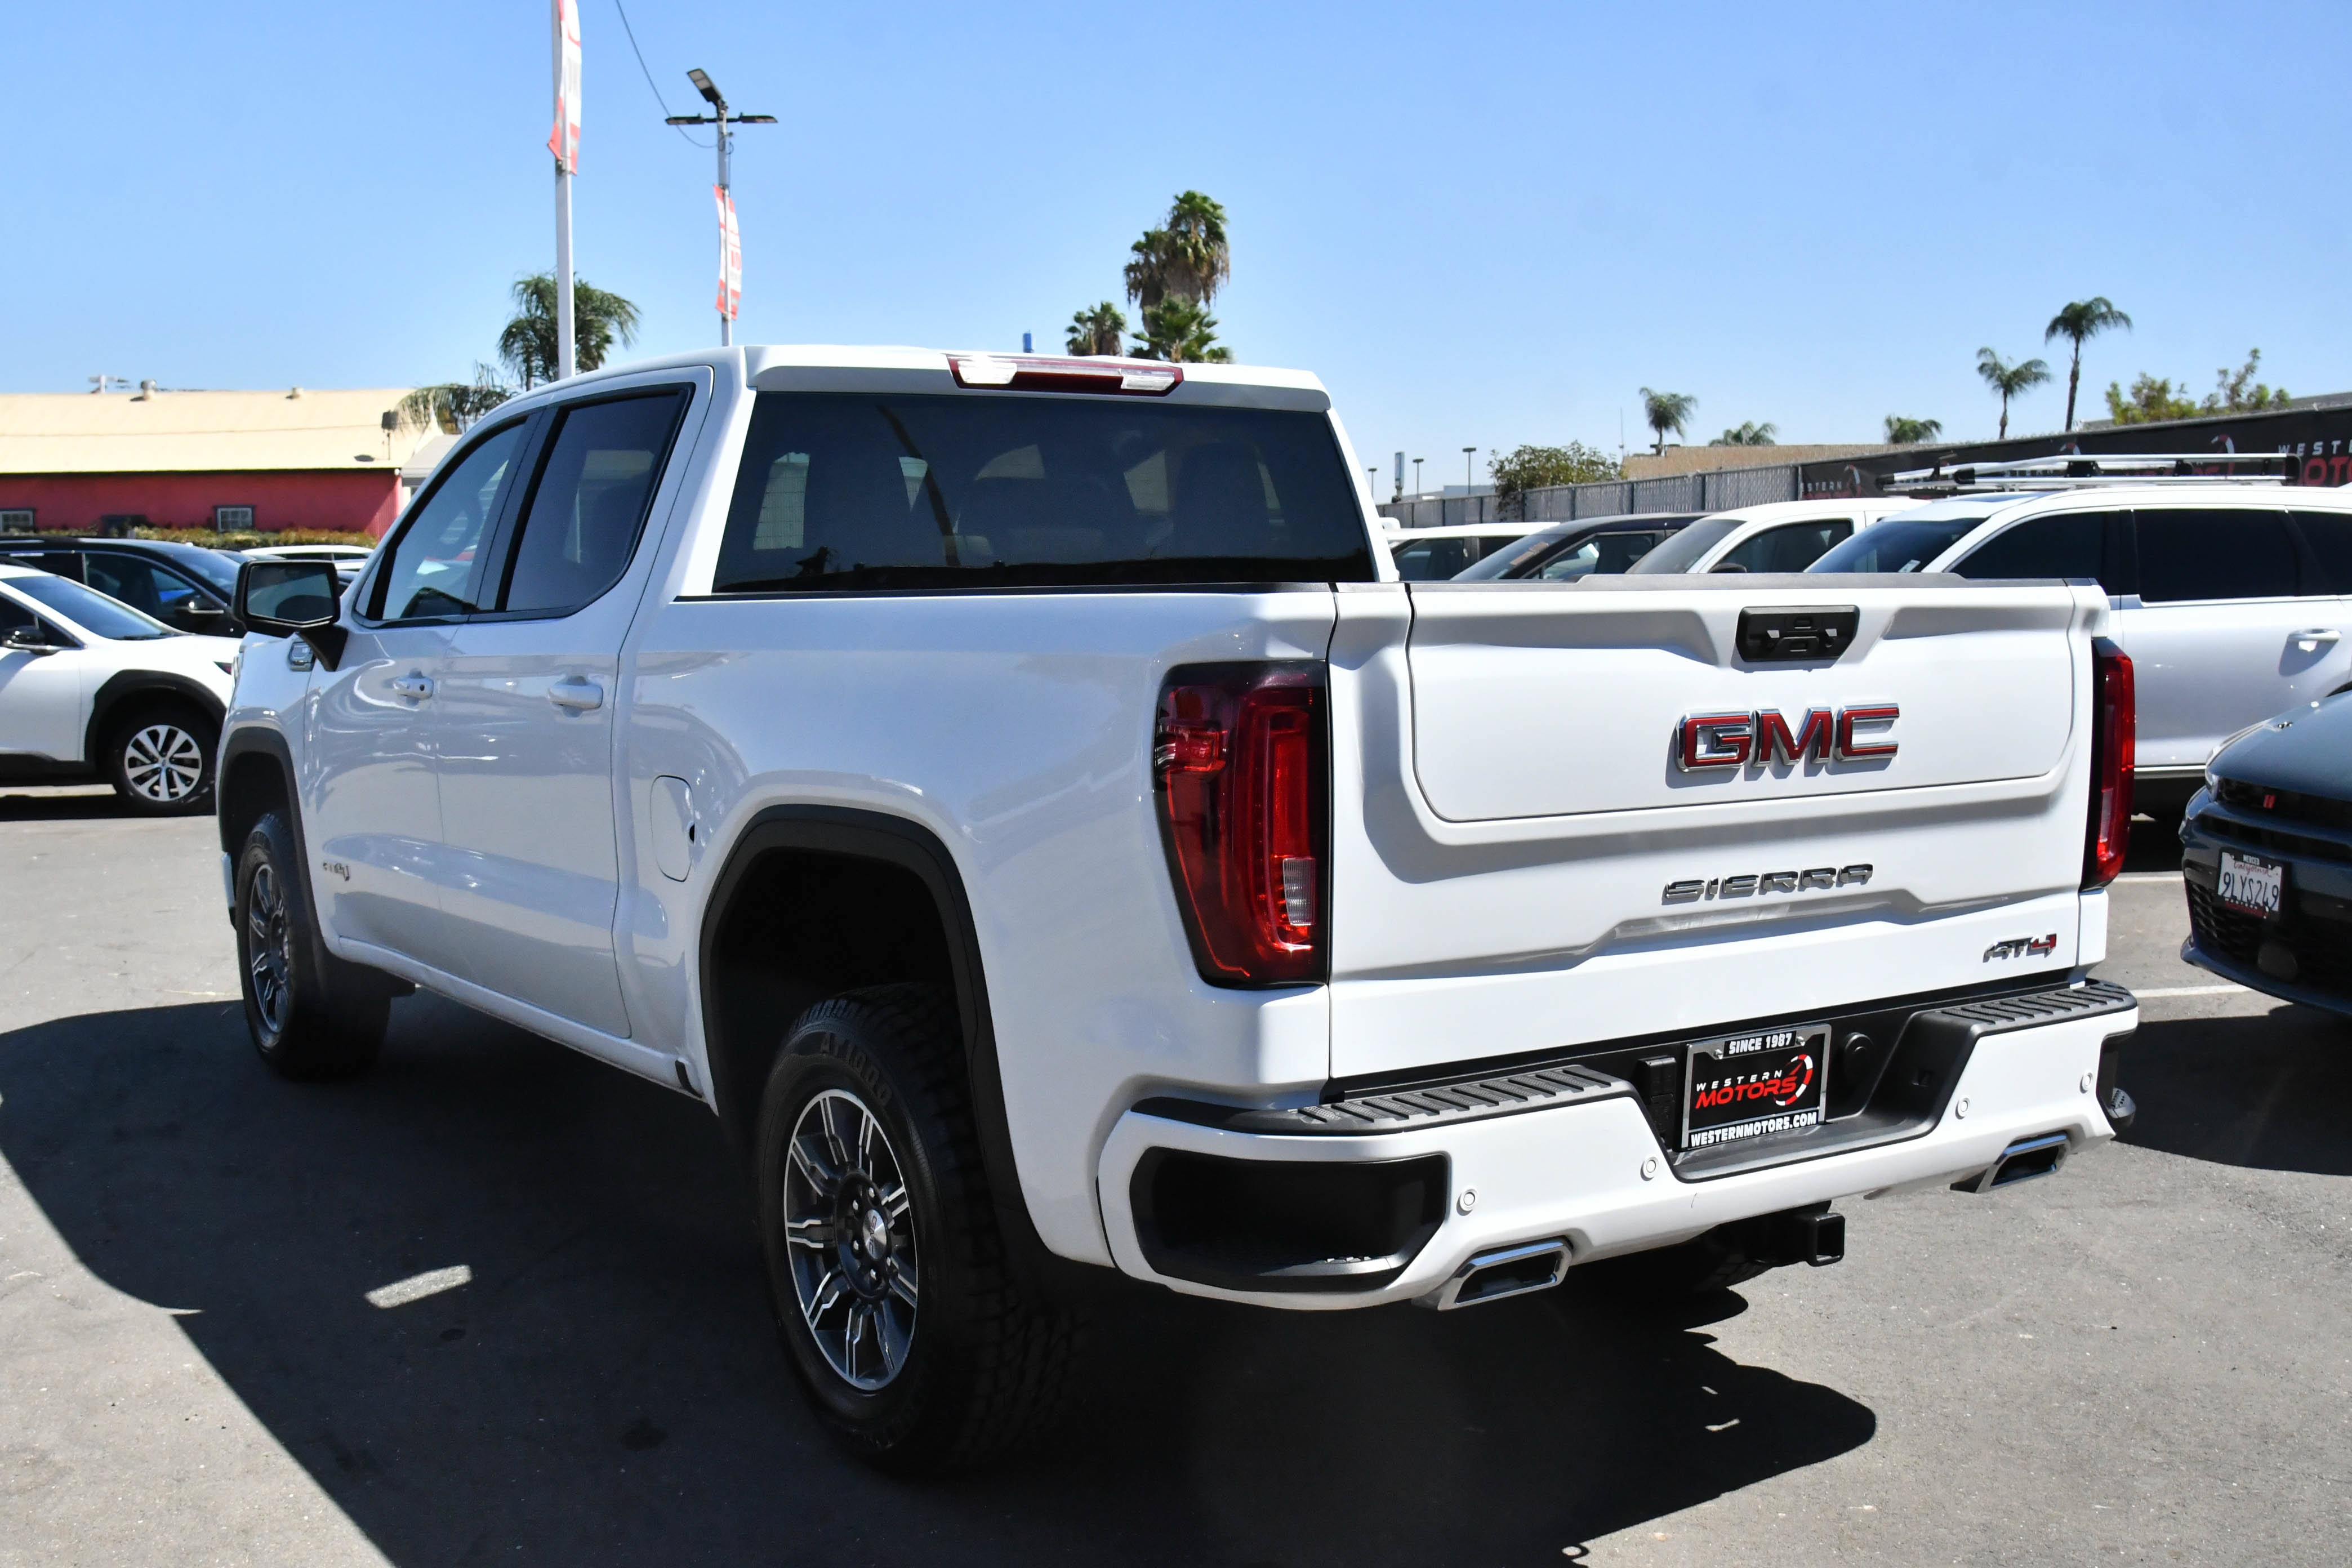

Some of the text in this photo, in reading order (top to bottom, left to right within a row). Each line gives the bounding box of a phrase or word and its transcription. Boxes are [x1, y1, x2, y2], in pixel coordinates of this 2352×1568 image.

[1800, 480, 1842, 492] ESTERN
[1676, 702, 1900, 772] GMC
[1665, 863, 1873, 899] SIERRA
[1984, 933, 2057, 957] AT4
[1729, 1033, 1792, 1054] SINCE 1987
[1695, 1076, 1798, 1109] MOTORS
[1696, 1070, 1783, 1092] WESTERN
[1691, 1112, 1817, 1147] WESTERNMOTORS.COM
[868, 1215, 877, 1255] GMC
